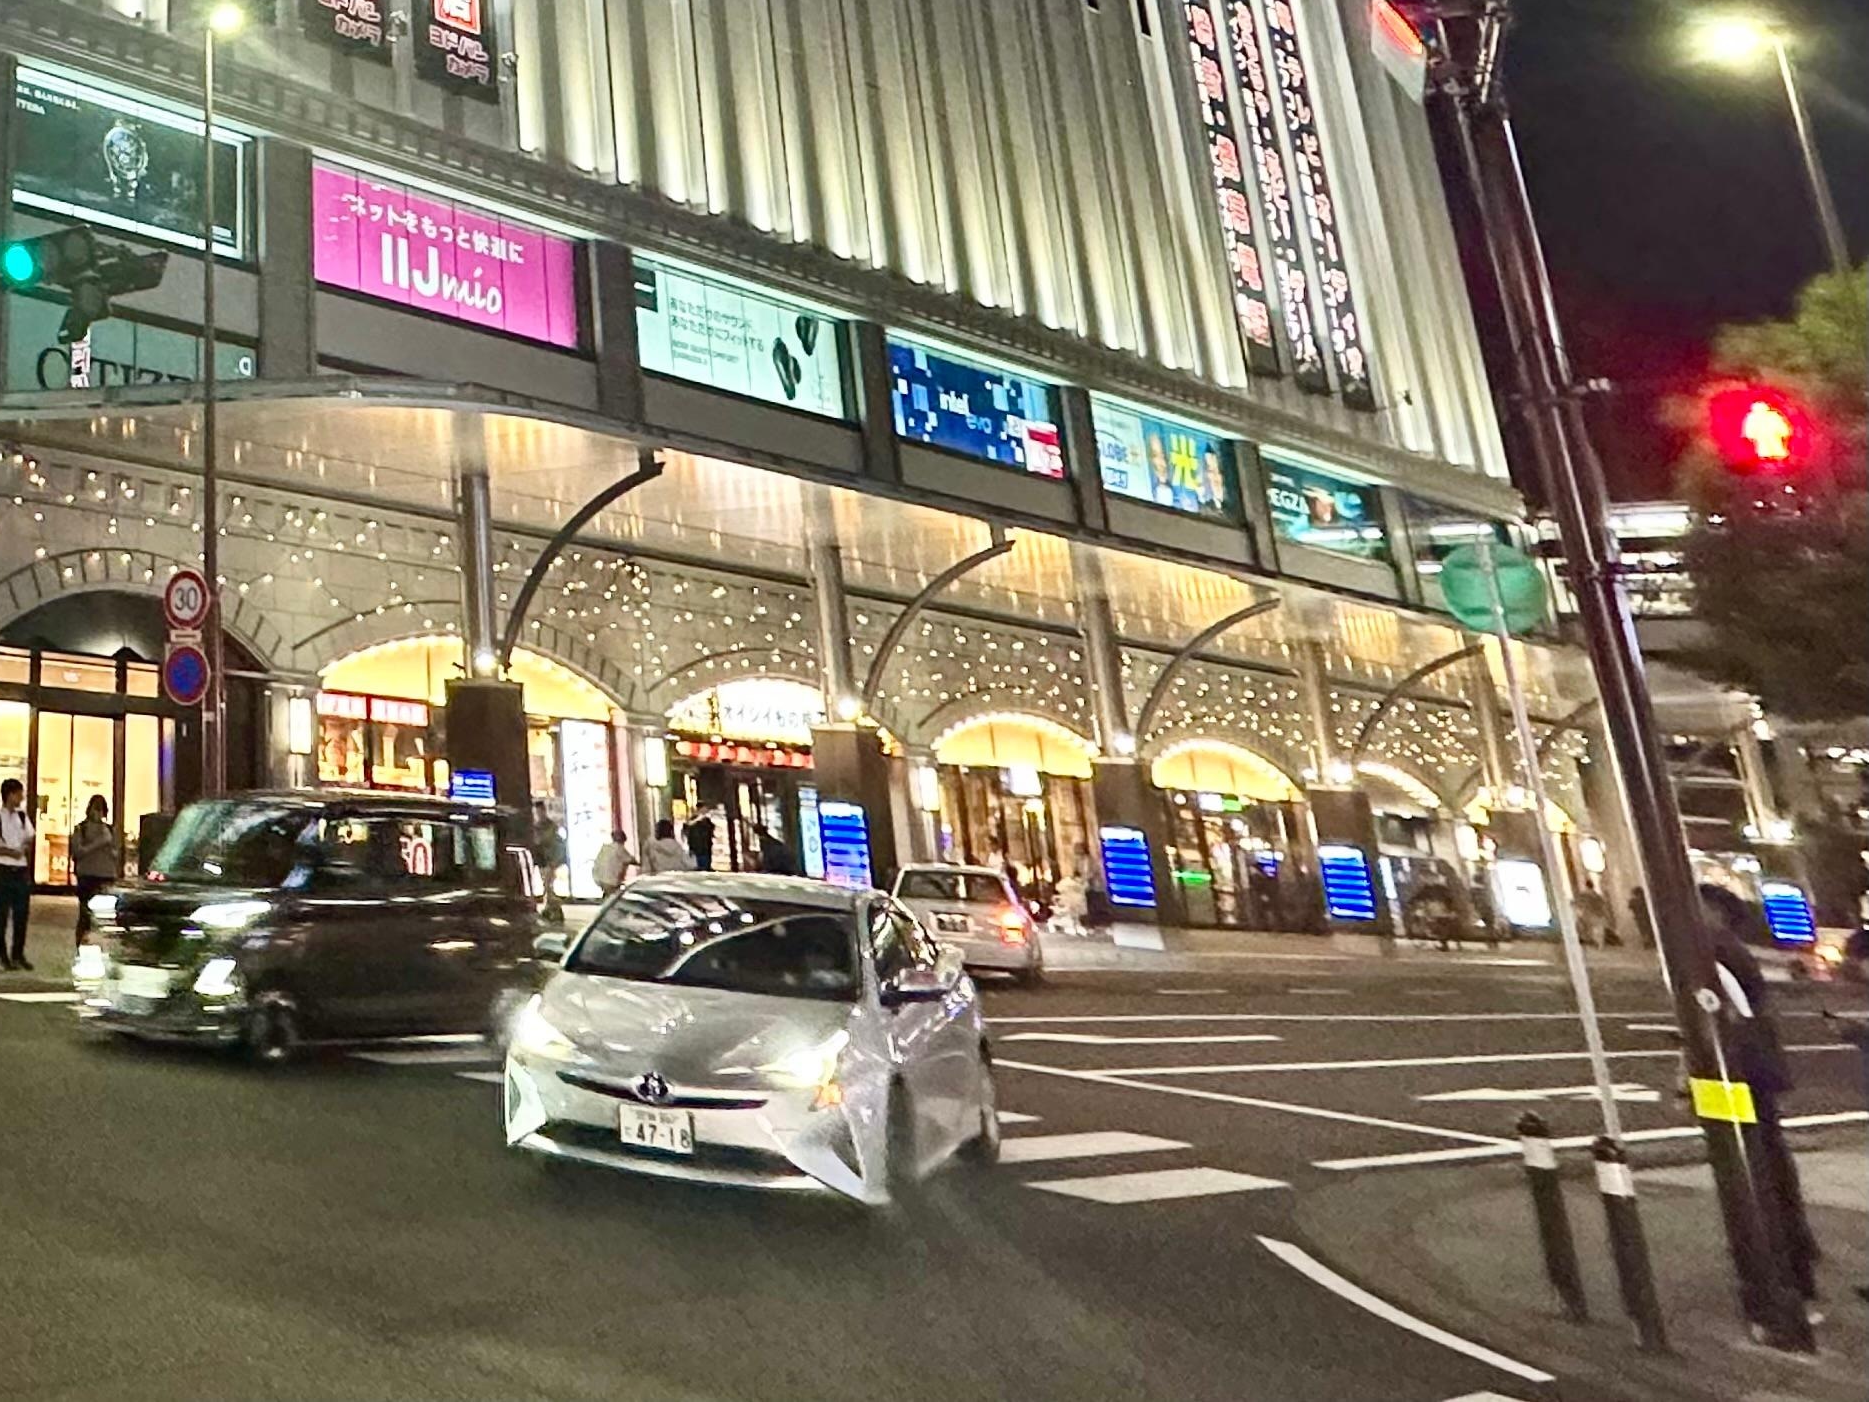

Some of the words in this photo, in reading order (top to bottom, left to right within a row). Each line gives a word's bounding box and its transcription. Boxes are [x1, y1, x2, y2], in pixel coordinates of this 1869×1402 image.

[335, 13, 381, 47] カメラ
[429, 23, 489, 62] ヨドバシ
[446, 53, 490, 85] カメラ
[341, 193, 524, 264] ネットをもっと快適に
[174, 585, 198, 612] 30
[636, 1123, 691, 1149] 47-18
